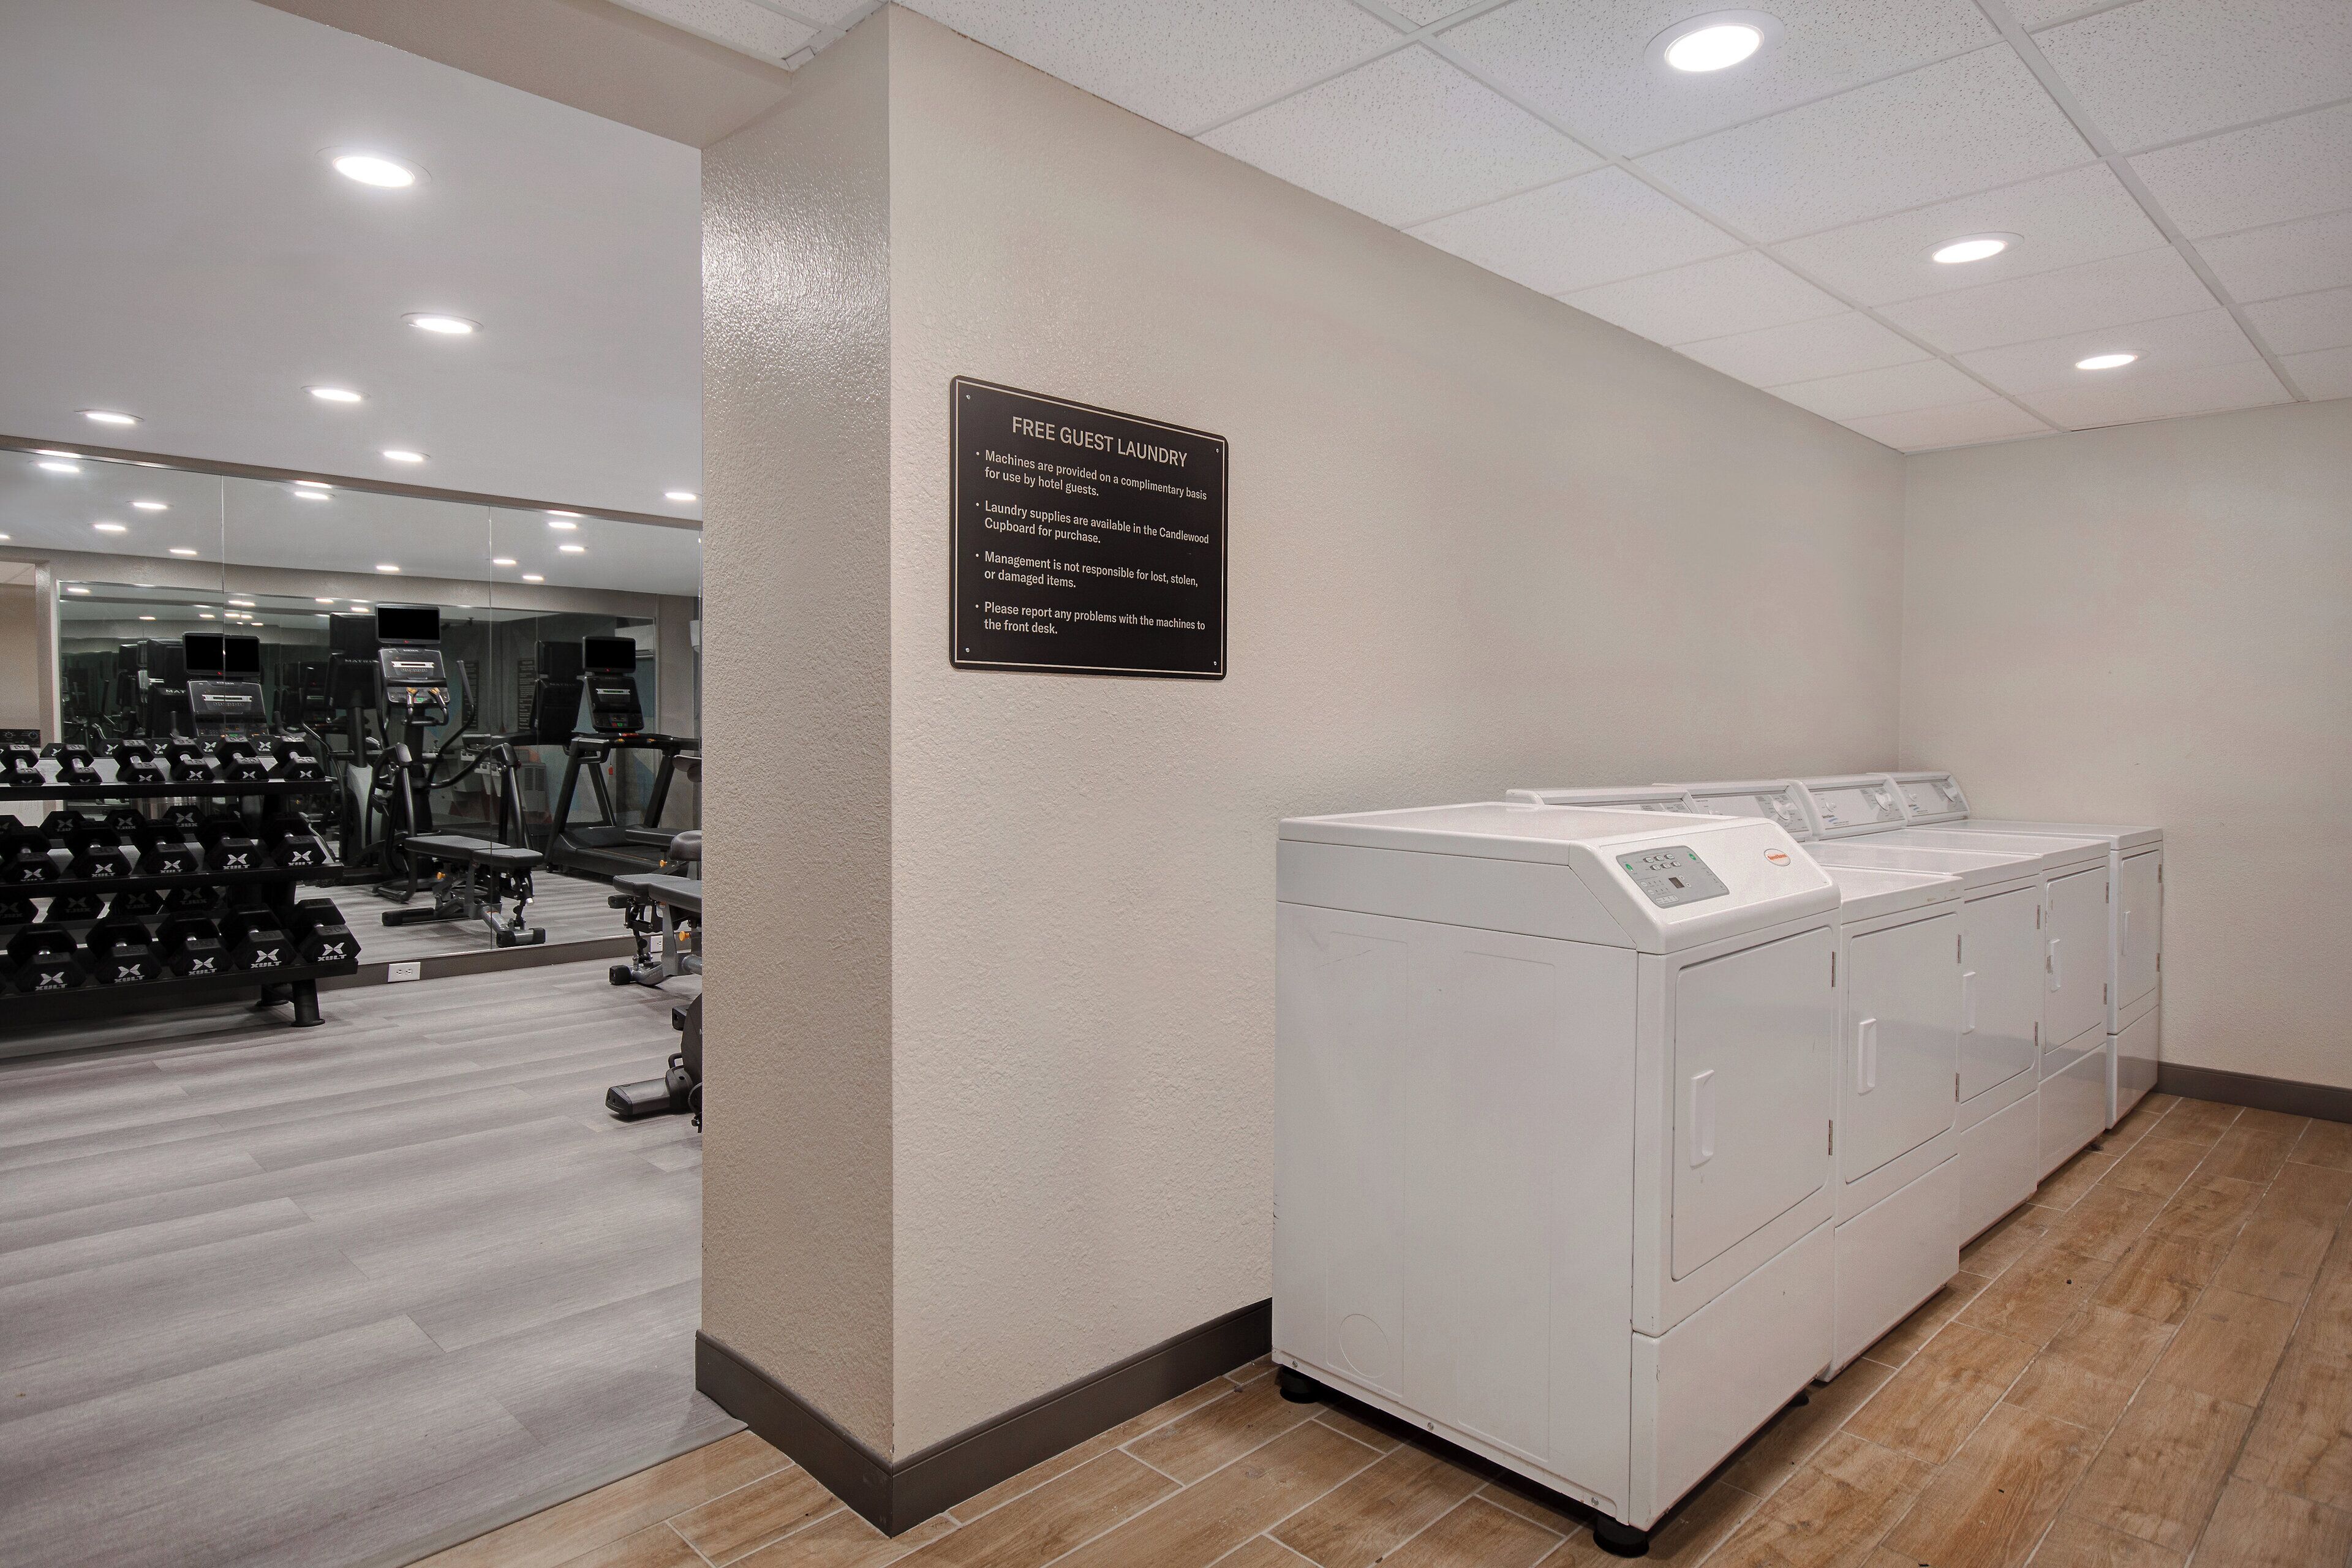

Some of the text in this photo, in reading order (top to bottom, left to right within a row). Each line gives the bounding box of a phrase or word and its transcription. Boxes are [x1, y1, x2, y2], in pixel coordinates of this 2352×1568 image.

[1012, 416, 1188, 467] FREE GUEST LAUNDRY
[984, 466, 1099, 496] for use by hotel guests.
[986, 449, 1207, 500] Machines are provided on a complimentary basis
[984, 517, 1101, 543] Cupboard for purchase.
[985, 500, 1209, 544] Laundry supplies are available in the Candlewood
[984, 569, 1076, 588] or damaged items.
[985, 551, 1198, 587] Management is not responsible for lost, stolen,
[984, 601, 1205, 630] Please report any problems with the machines to
[984, 618, 1058, 635] the front desk.
